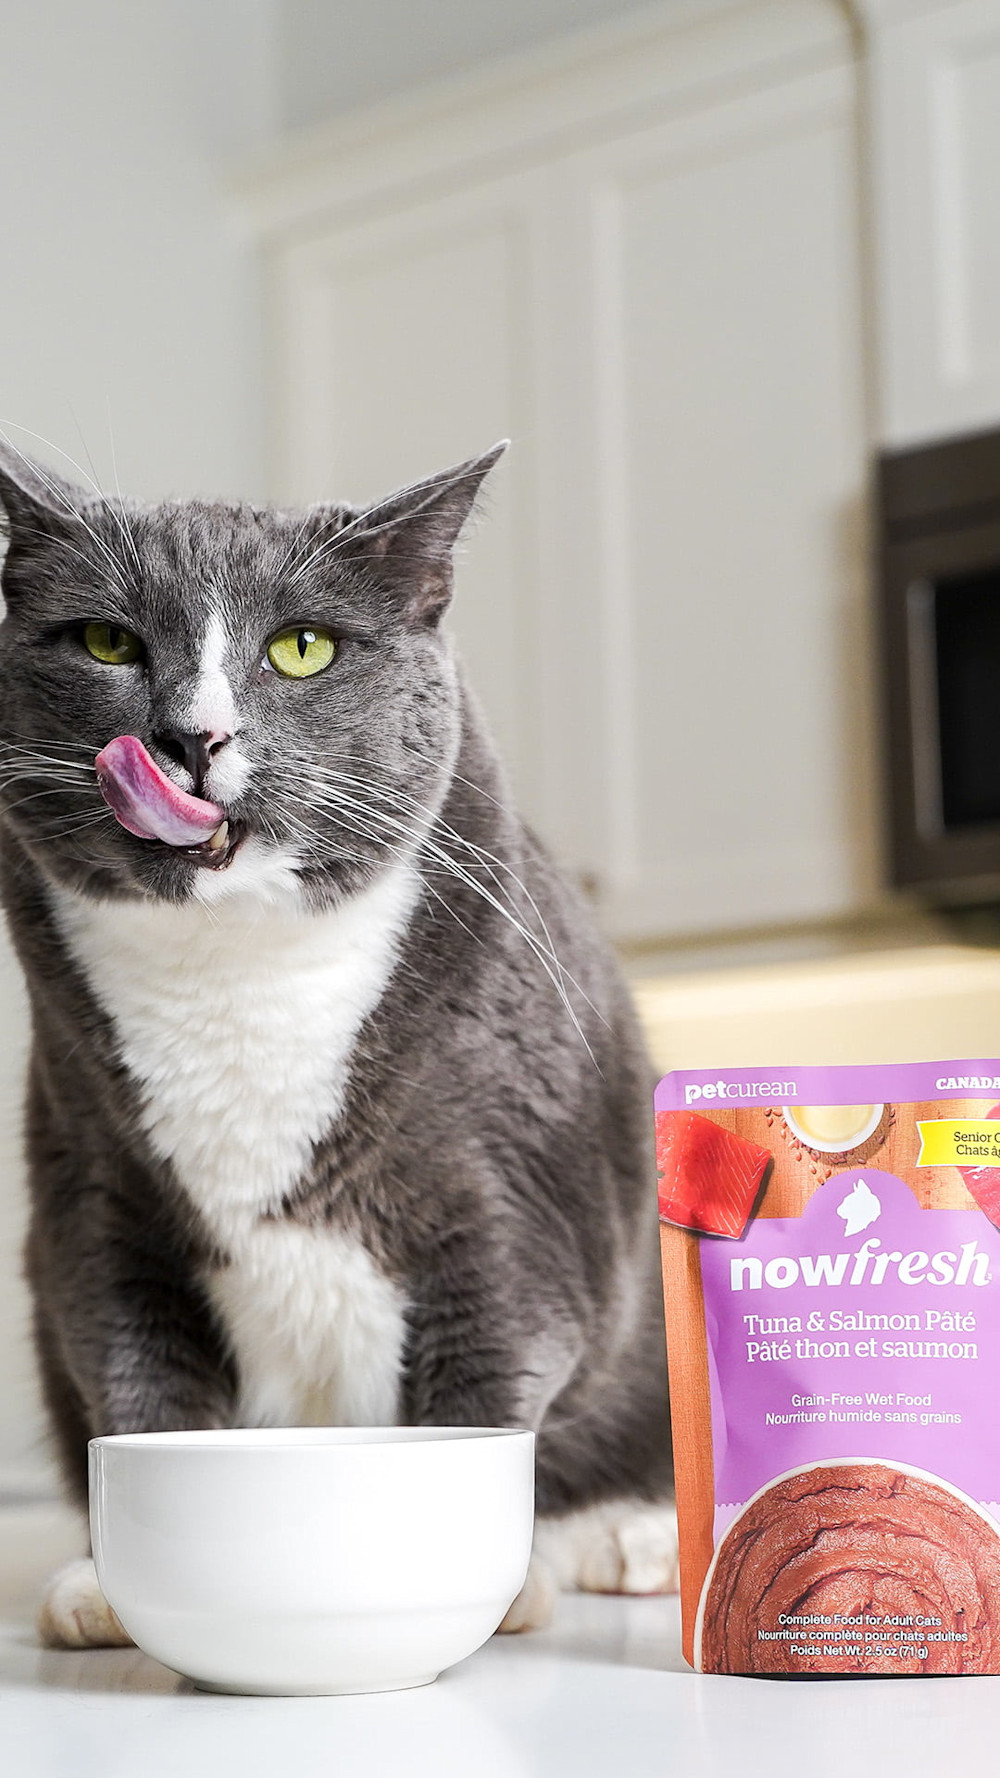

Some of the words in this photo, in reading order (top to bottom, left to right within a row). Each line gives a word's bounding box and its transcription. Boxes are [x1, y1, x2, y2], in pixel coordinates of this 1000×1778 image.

[936, 1076, 1000, 1090] CANADA
[685, 1080, 797, 1104] petcurean
[953, 1131, 991, 1143] Senior
[956, 1144, 989, 1156] Chats
[744, 1315, 802, 1335] Tuna
[806, 1311, 825, 1332] &
[829, 1311, 920, 1331] Salmon
[925, 1311, 976, 1331] Pâté
[746, 1341, 791, 1362] Pâté
[796, 1339, 850, 1358] thon
[855, 1338, 878, 1358] et
[882, 1342, 978, 1359] saumon
[791, 1393, 862, 1407] Grain-Free
[865, 1392, 893, 1405] Wet
[896, 1392, 932, 1406] Food
[765, 1411, 826, 1425] Nourriture
[829, 1410, 881, 1422] humide
[884, 1411, 917, 1423] sans
[920, 1411, 962, 1425] grains
[778, 1614, 831, 1627] Complete
[834, 1616, 863, 1625] Food
[865, 1615, 882, 1625] for
[884, 1615, 914, 1626] Adult
[915, 1616, 942, 1626] Cats
[758, 1630, 807, 1641] Nourriture
[809, 1630, 863, 1643] complète
[865, 1632, 891, 1643] pour
[893, 1631, 925, 1641] chats
[927, 1631, 968, 1642] adultes
[790, 1645, 821, 1656] Poids
[823, 1646, 844, 1656] Net
[844, 1646, 864, 1656] Wt.
[865, 1646, 882, 1656] 2.5
[884, 1648, 898, 1657] oz
[899, 1646, 916, 1658] (71
[917, 1646, 928, 1659] g)
